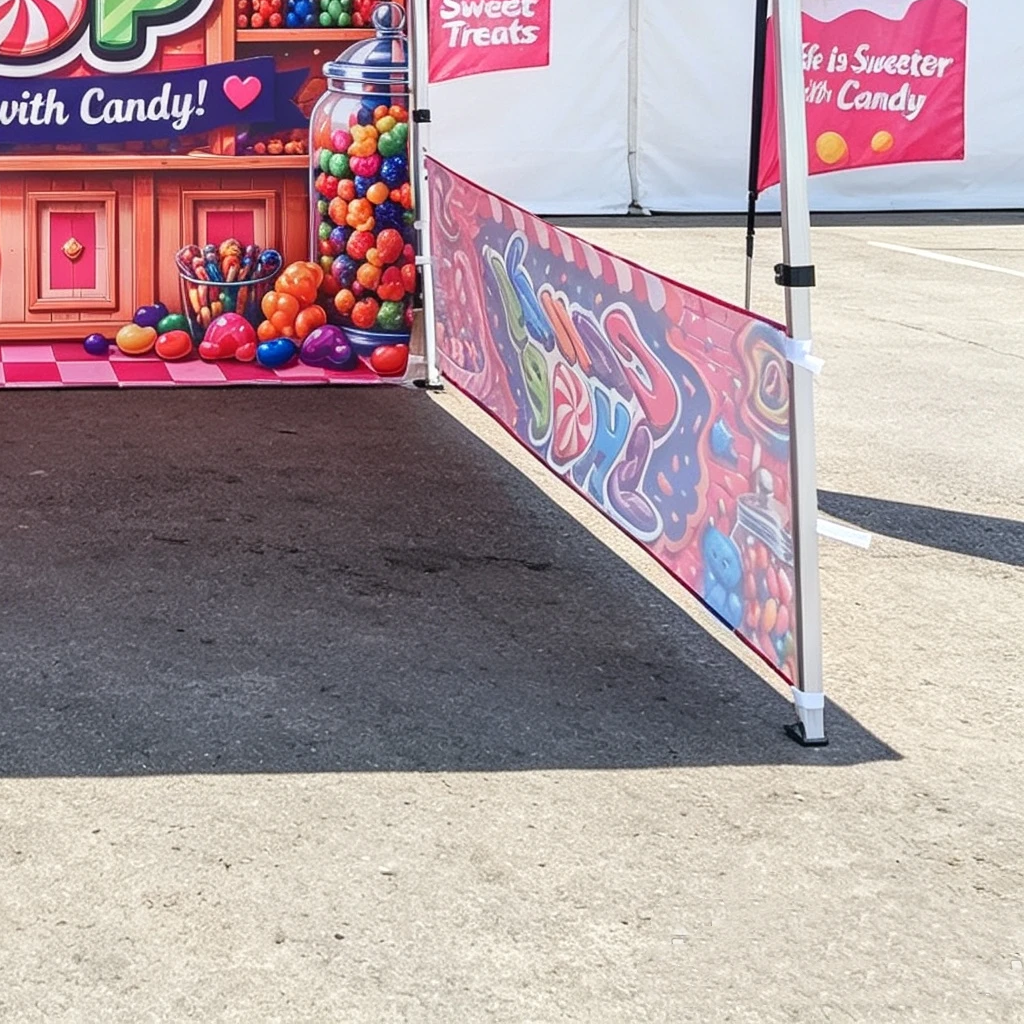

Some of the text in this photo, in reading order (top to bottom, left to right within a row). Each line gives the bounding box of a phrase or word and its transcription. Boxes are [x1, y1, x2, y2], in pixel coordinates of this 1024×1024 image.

[442, 19, 540, 48] Treats
[80, 78, 208, 130] Candy!
[836, 79, 927, 121] Candy
